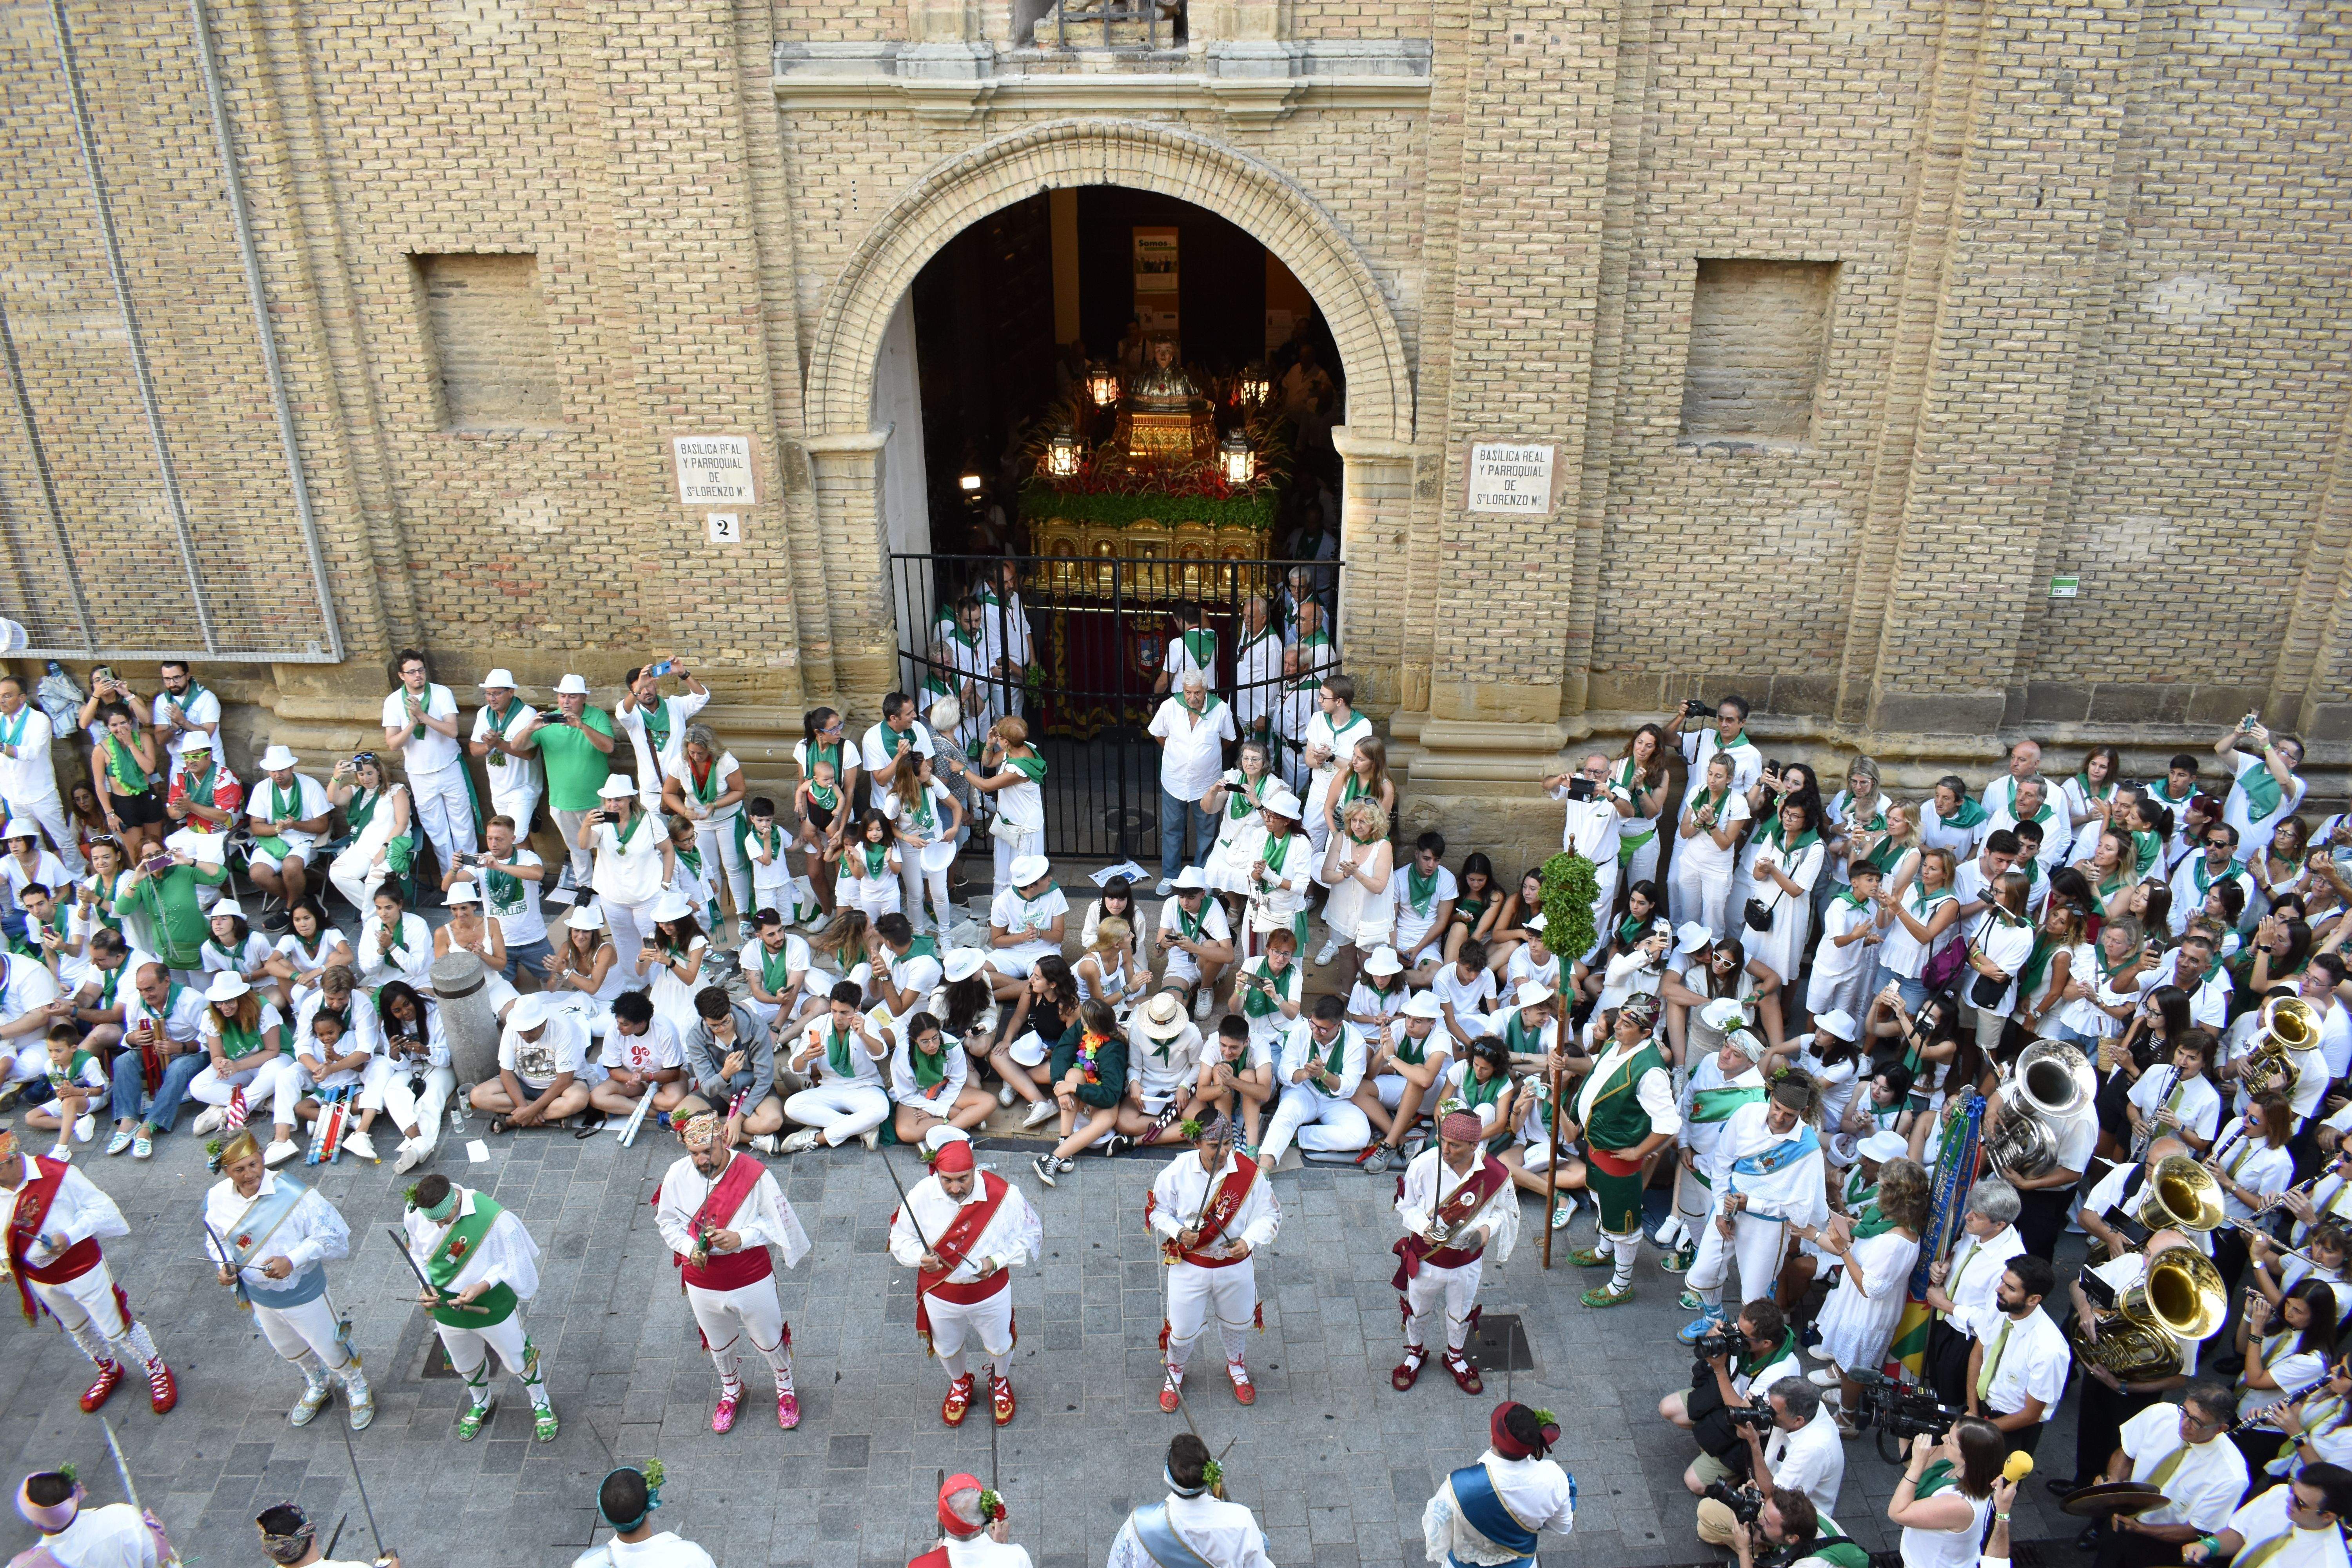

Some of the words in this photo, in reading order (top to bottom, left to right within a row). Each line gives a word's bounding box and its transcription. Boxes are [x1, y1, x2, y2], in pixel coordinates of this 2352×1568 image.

[1523, 451, 1545, 463] REAL
[683, 458, 688, 468] Y
[692, 458, 743, 470] PARROQUIAL
[709, 472, 720, 483] DE
[1480, 465, 1485, 475] Y
[1488, 465, 1544, 478] PARROQUIAL
[1504, 480, 1516, 491] DE
[717, 520, 729, 535] 2
[1101, 872, 1116, 880] ESPACIO
